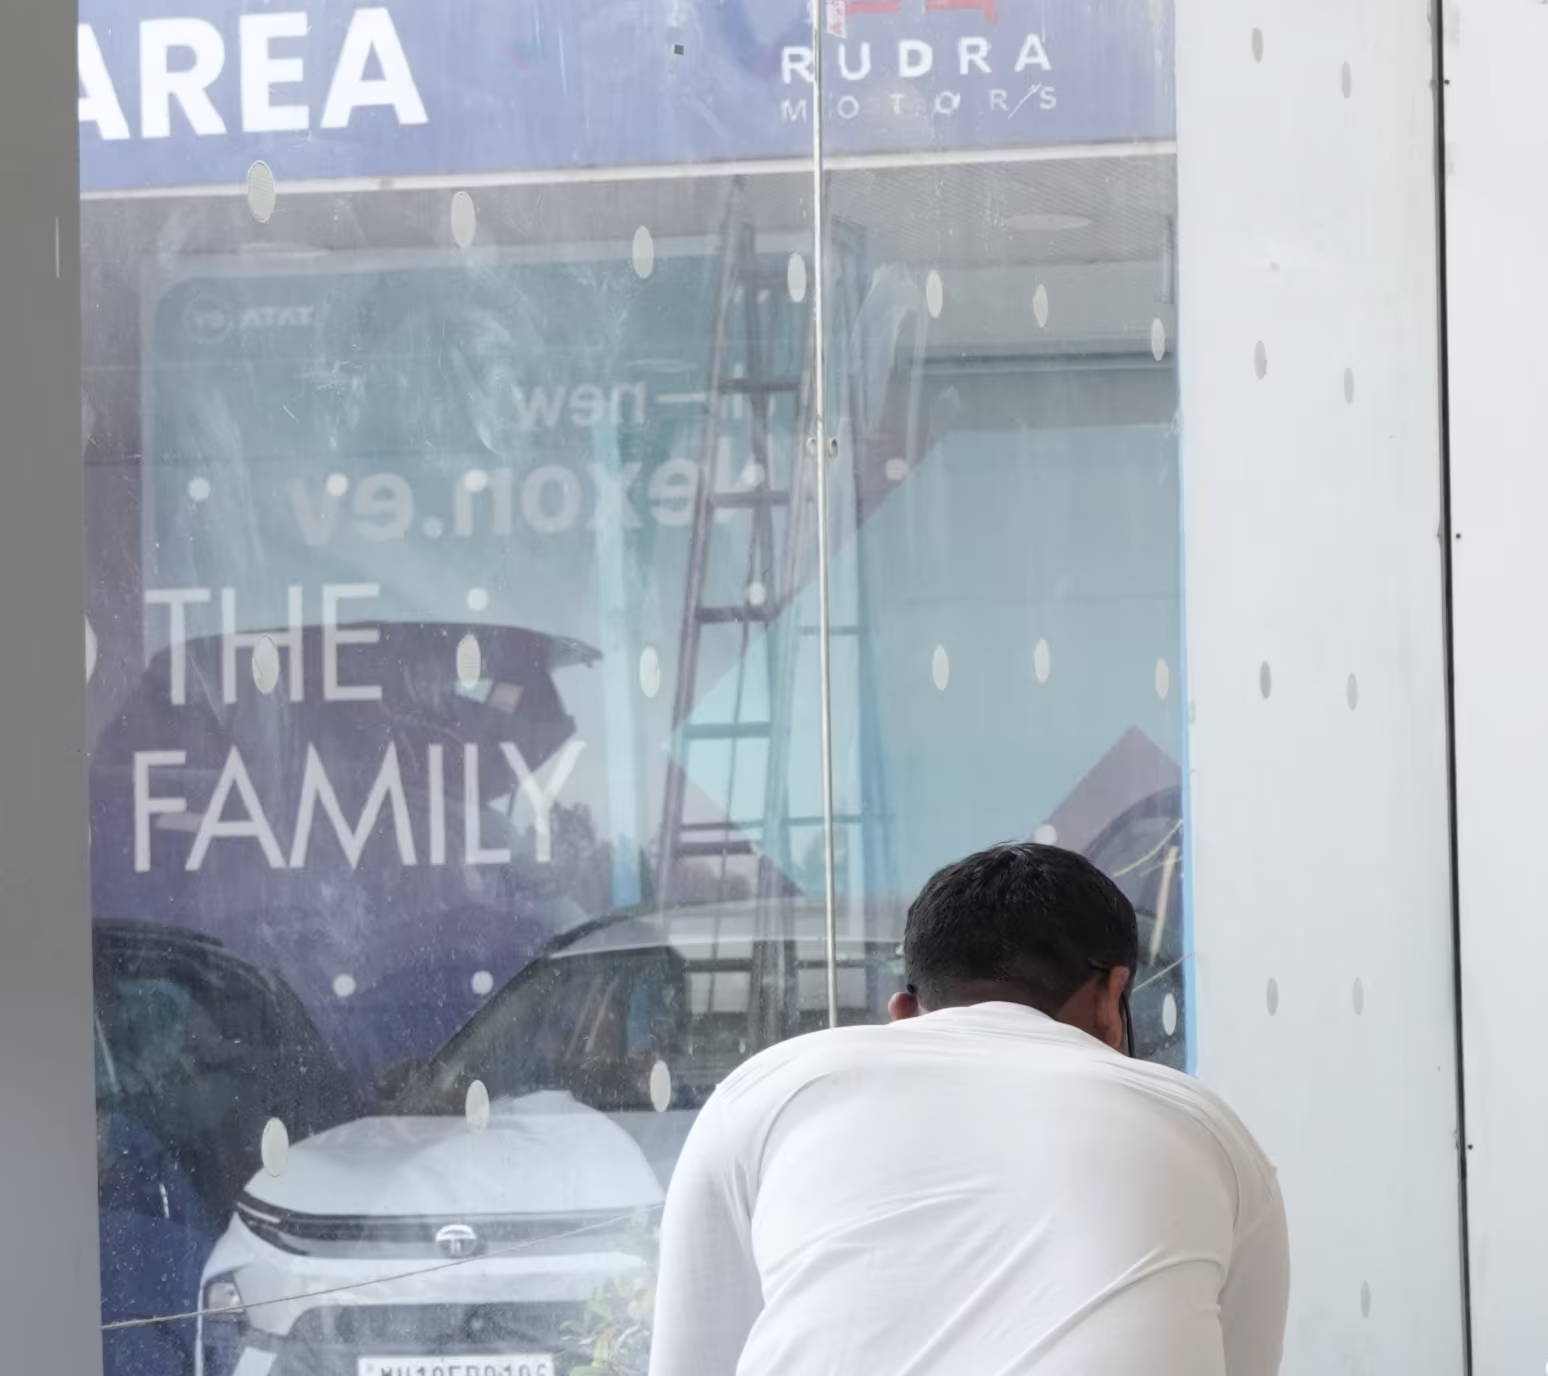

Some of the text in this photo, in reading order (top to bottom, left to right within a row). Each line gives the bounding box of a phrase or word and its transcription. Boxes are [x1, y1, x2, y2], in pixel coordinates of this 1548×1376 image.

[781, 34, 1052, 84] RUDRA
[781, 85, 1058, 121] MOTORS
[146, 584, 381, 706] THE
[132, 741, 586, 873] FAMILY
